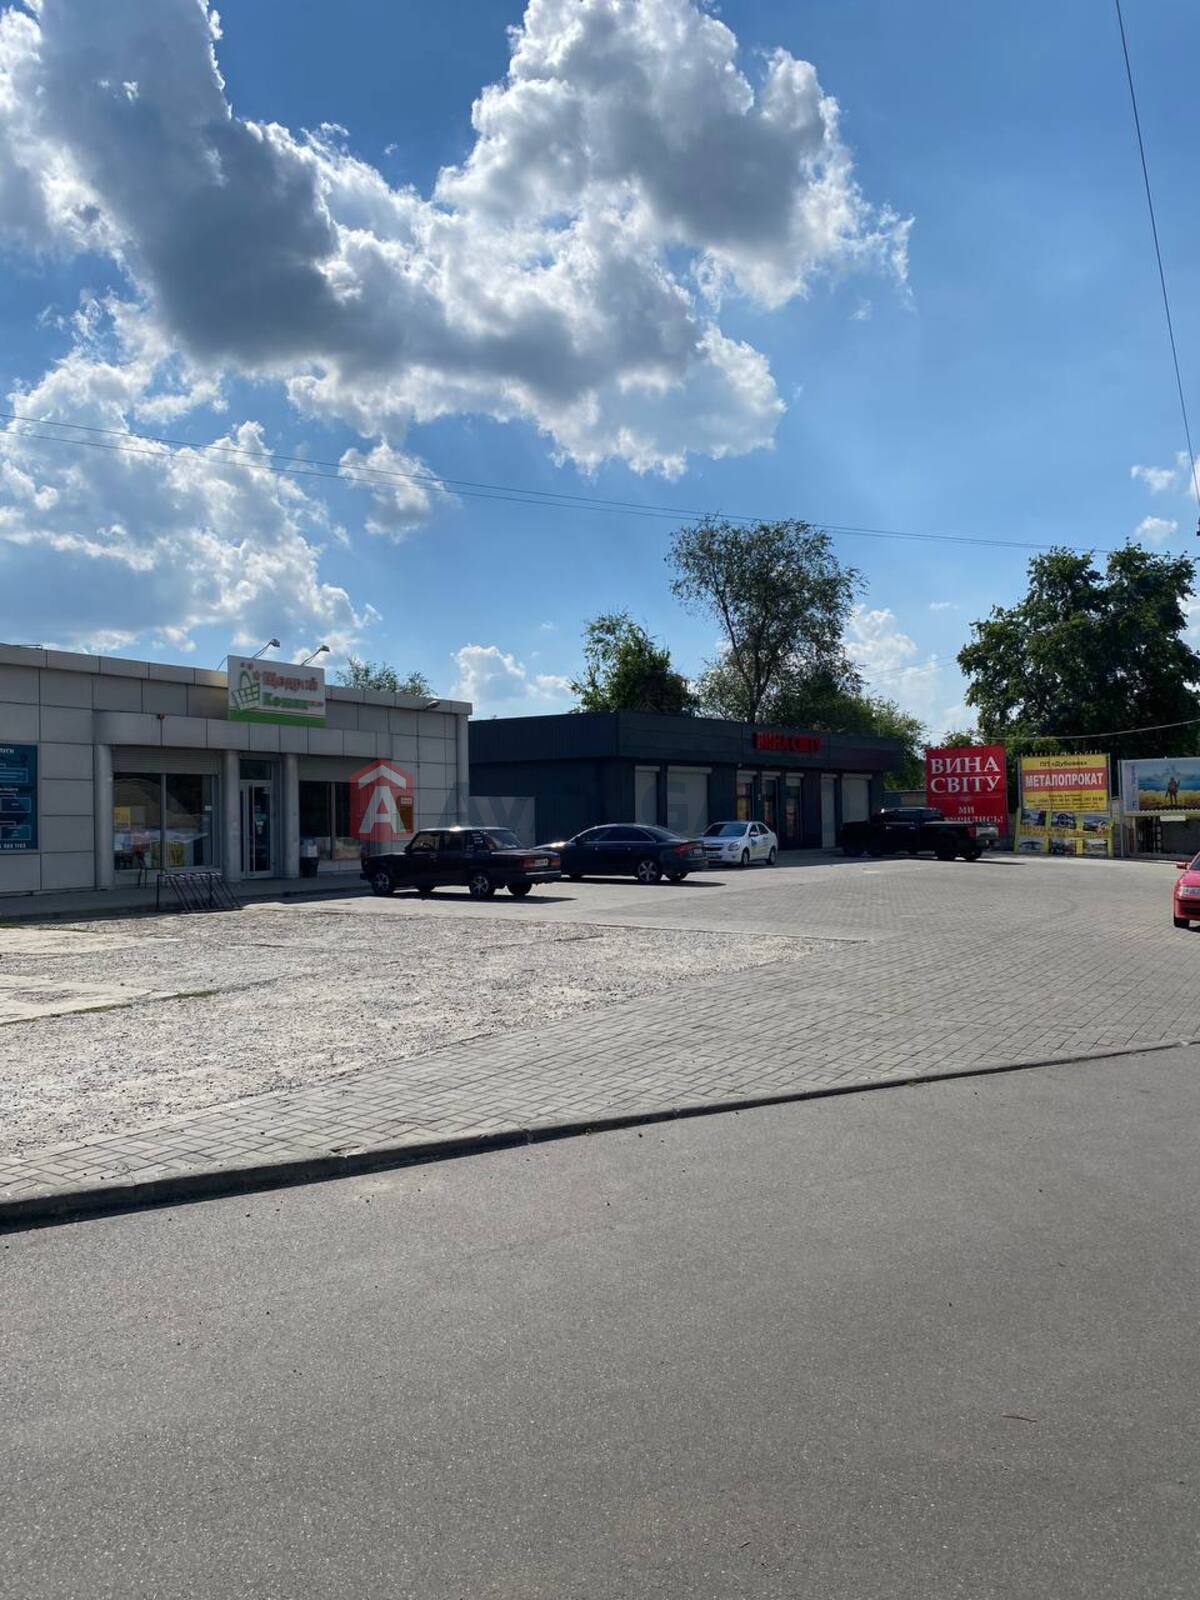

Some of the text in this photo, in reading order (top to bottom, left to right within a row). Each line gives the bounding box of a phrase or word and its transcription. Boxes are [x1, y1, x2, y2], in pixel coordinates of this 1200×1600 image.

[930, 756, 1001, 775] ВИНА
[930, 775, 1002, 794] СВІТУ
[1025, 772, 1104, 788] МЕТАЛОПРОКАТ
